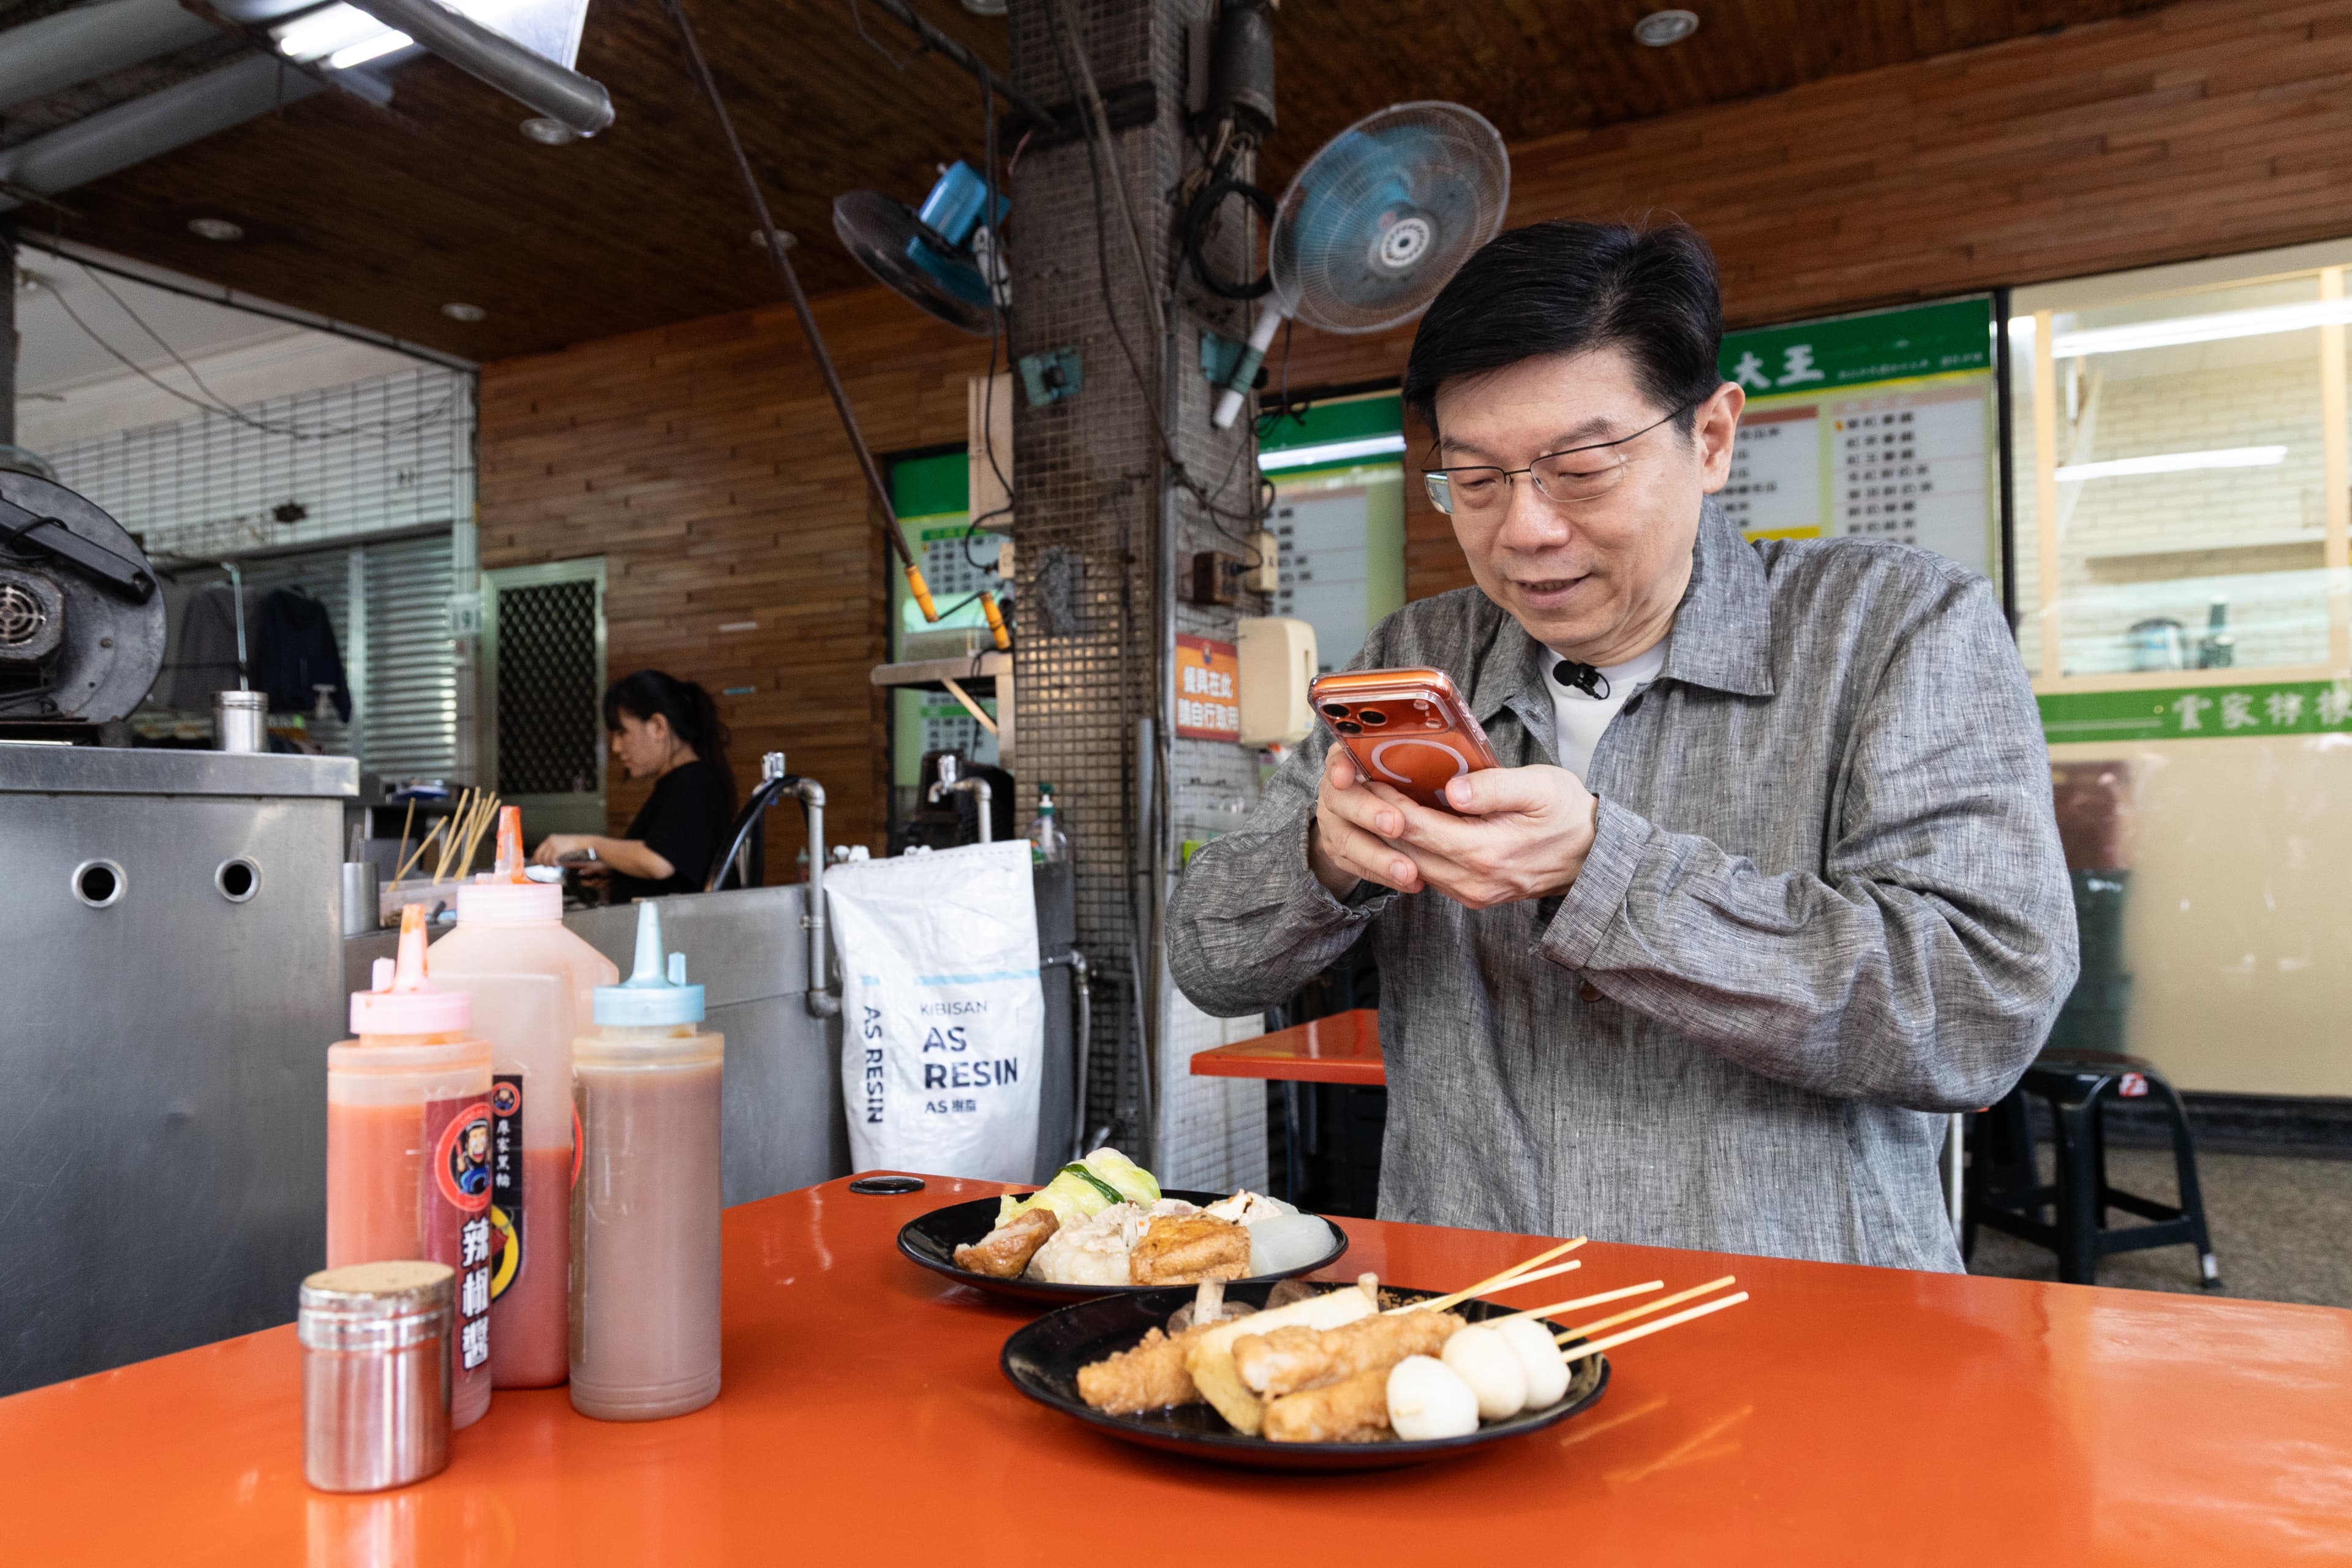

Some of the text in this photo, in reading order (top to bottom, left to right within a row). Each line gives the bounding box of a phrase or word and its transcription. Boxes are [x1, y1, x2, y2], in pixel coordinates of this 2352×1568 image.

[1733, 344, 1825, 389] 大王
[920, 1001, 987, 1016] KIBISAN
[922, 1026, 967, 1053] AS
[864, 1005, 883, 1124] AS RESIN
[924, 1057, 1018, 1090] RESIN
[925, 1100, 948, 1114] AS
[462, 1215, 489, 1370] 辣椒醬
